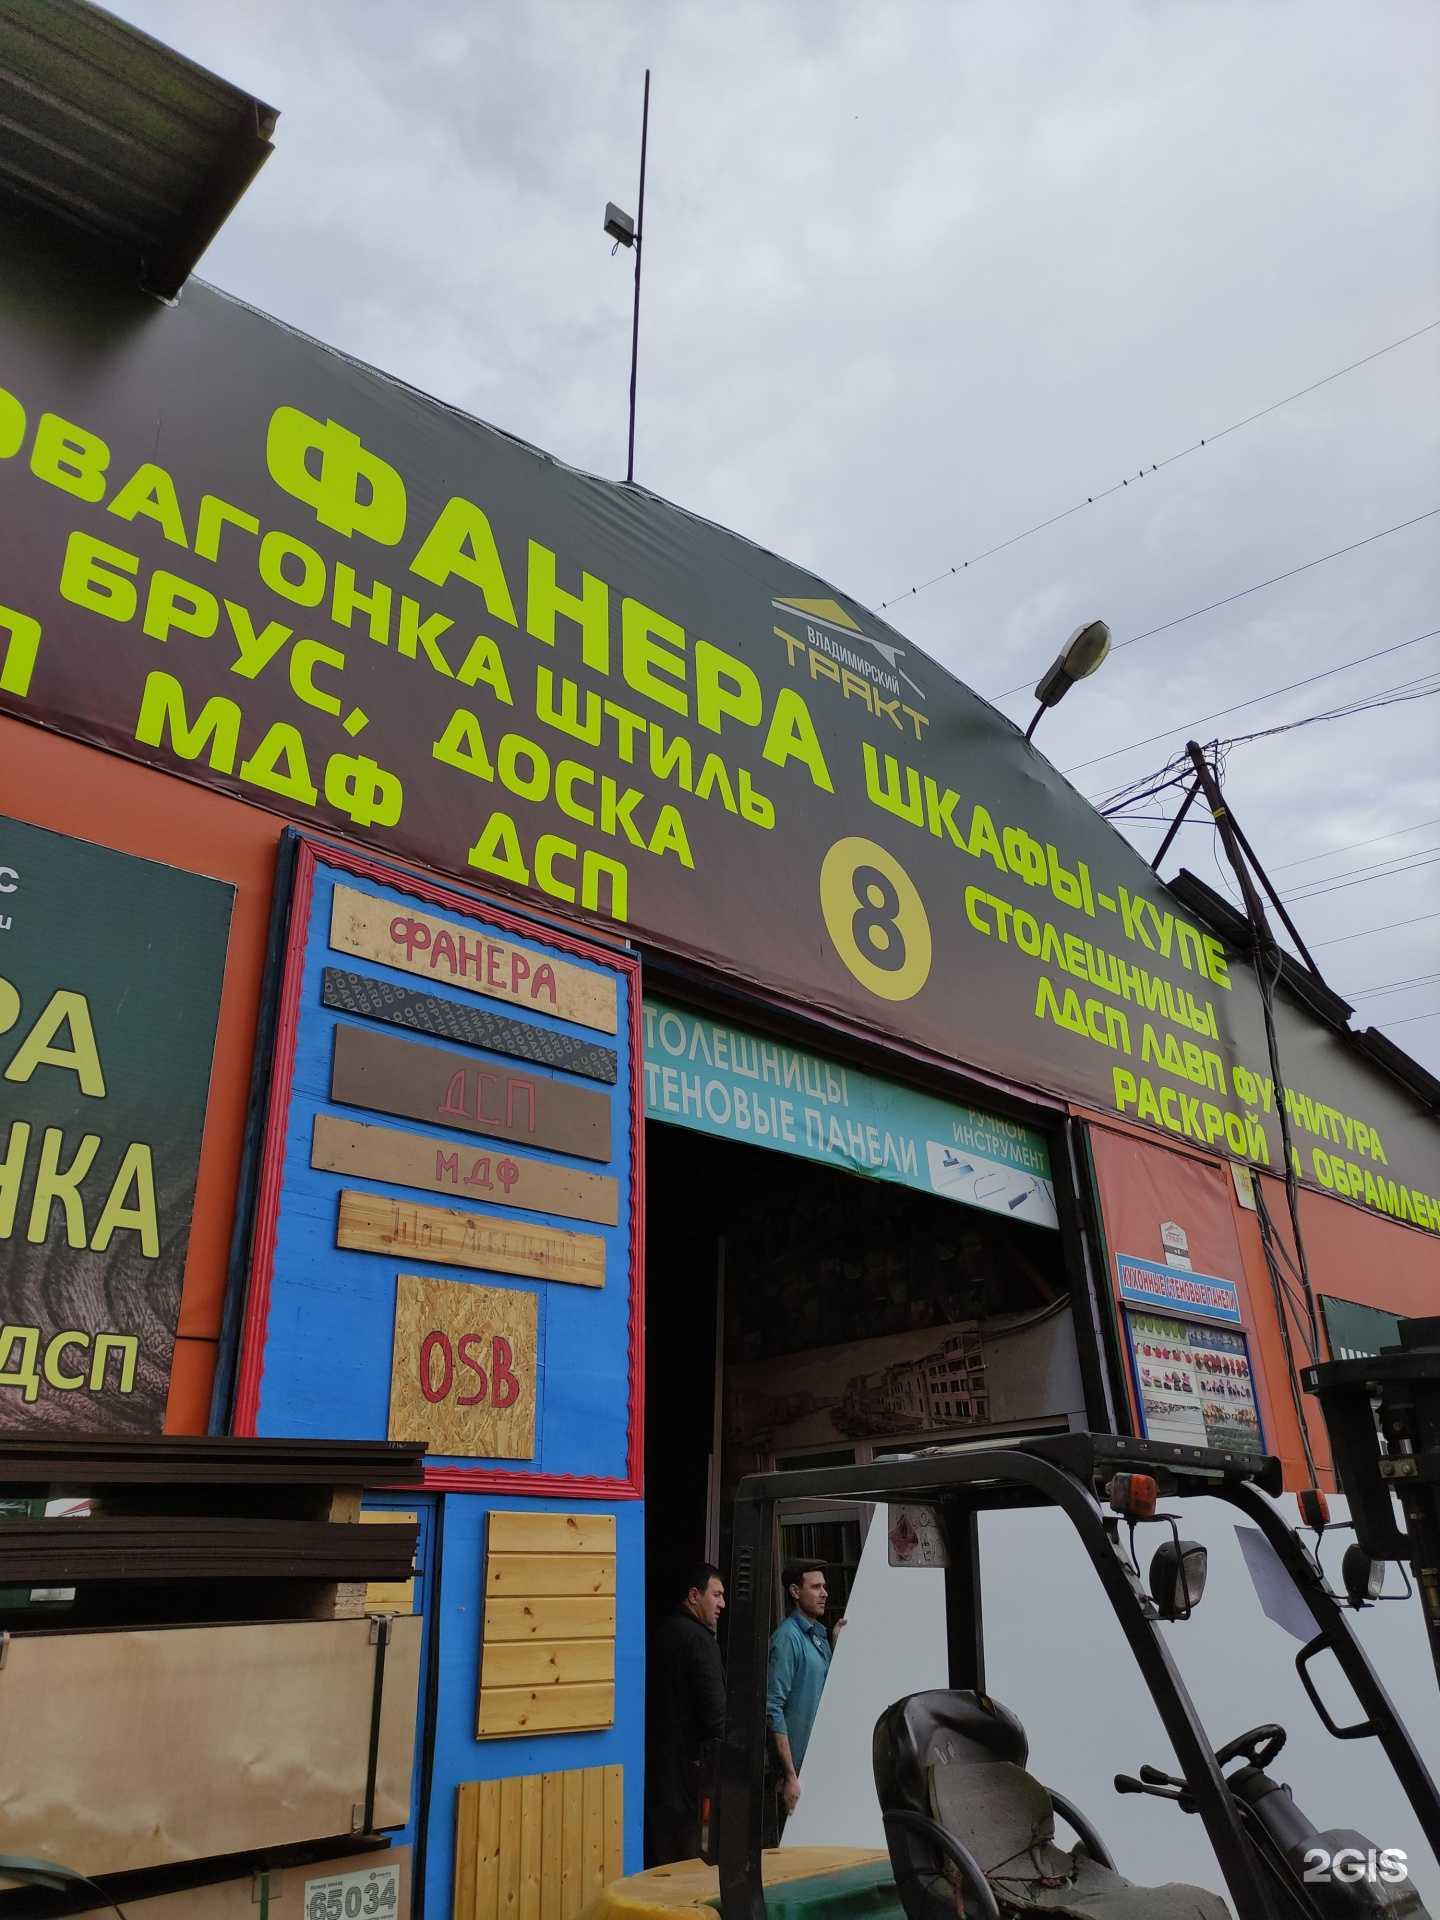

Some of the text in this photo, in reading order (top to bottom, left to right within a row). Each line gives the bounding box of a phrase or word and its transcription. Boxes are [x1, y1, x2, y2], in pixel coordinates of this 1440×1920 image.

[264, 404, 836, 794] ФАНЕРА
[58, 530, 696, 870] БРУС, ДОСКА
[773, 625, 930, 742] ТРАКТ
[807, 625, 901, 697] ВЛАДИМИРСКИЙ
[134, 670, 405, 829] МДФ
[467, 810, 630, 923] ДСП
[534, 664, 777, 831] ШТИЛЬ
[862, 741, 1233, 991] ШКАФЫ-КУПЕ
[389, 915, 558, 1004] ФАНЕРА
[852, 865, 907, 972] 8
[963, 884, 1220, 1041] СТОЛЕШНИЦЫ
[1034, 975, 1133, 1056] ЛДСП
[1141, 1023, 1229, 1097] ЛДВП
[437, 1069, 537, 1134] ДСП
[804, 1107, 919, 1177] ПАНЕЛИ
[952, 1120, 1046, 1172] ИНСТРУМЕНТ
[1111, 1065, 1271, 1166] РАСКРОЙ
[435, 1149, 520, 1193] МДФ
[419, 1330, 520, 1408] OSB
[309, 1878, 397, 1920] 65034
